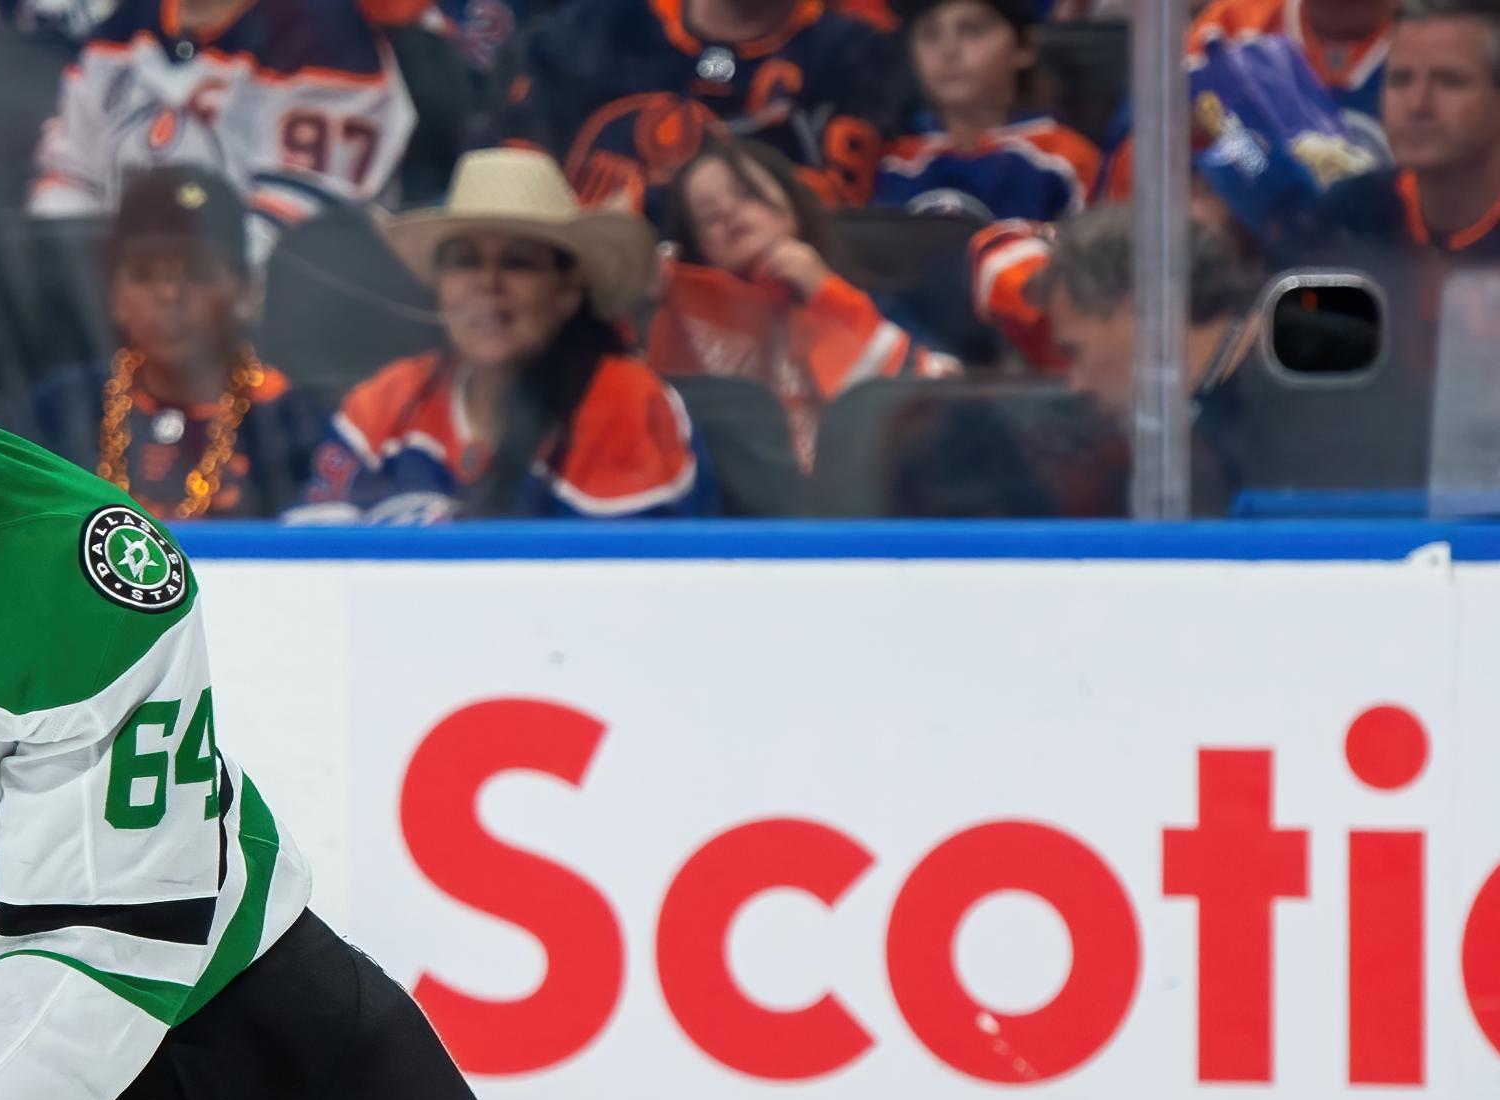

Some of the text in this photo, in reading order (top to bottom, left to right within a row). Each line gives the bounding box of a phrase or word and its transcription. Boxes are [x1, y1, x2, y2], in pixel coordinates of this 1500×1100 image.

[281, 108, 383, 186] 97
[92, 515, 151, 578] DALLAS
[131, 553, 181, 601] STARS
[104, 685, 220, 829] 64
[397, 694, 1500, 1087] Scoti
